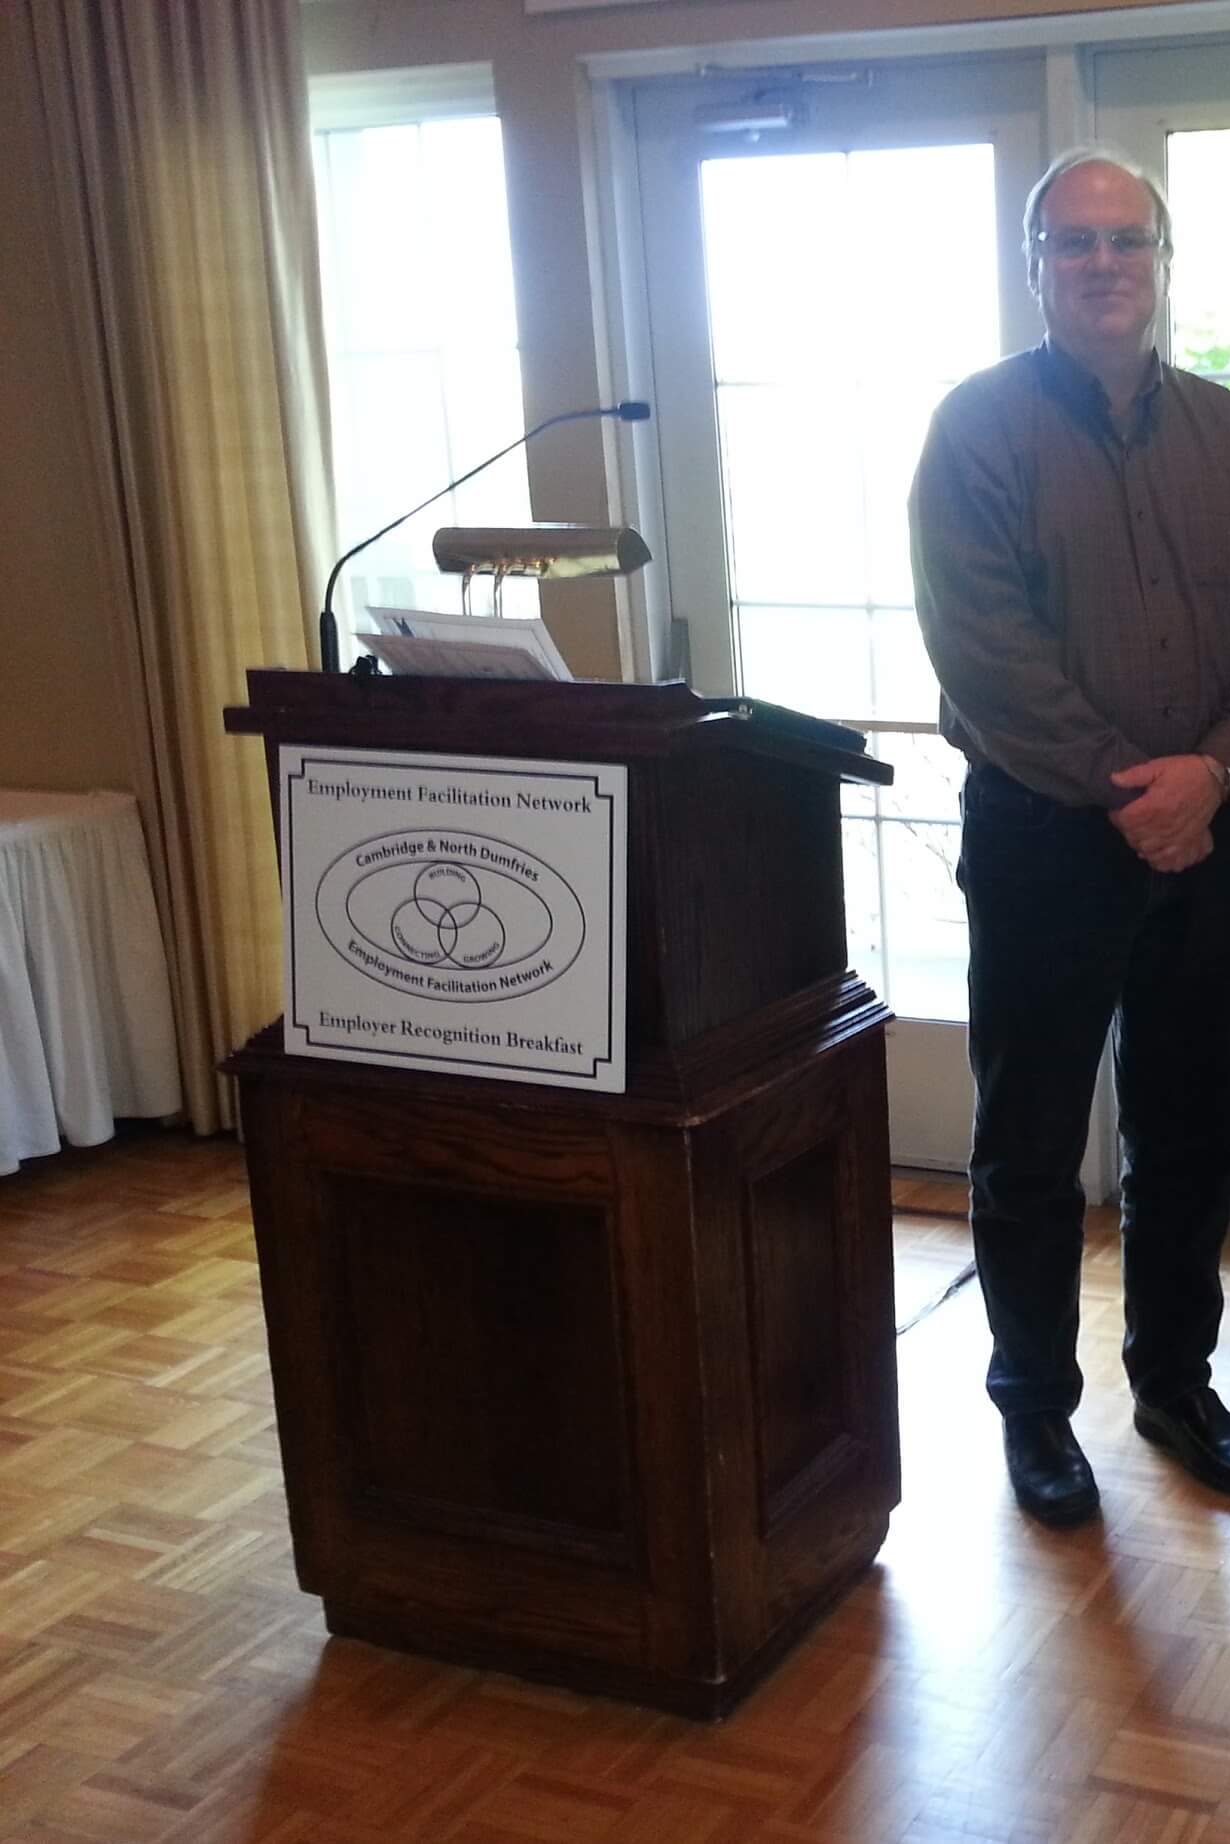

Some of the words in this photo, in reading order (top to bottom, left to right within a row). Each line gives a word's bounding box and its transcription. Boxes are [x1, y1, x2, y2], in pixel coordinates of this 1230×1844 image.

[307, 779, 413, 803] Employment
[418, 787, 511, 809] Facilitation
[516, 794, 592, 814] Network
[355, 840, 424, 868] Cambridge
[427, 839, 436, 852] &
[439, 839, 477, 857] North
[480, 846, 540, 882] Dumfries
[429, 867, 467, 883] BUILDING
[347, 940, 426, 988] Employment
[427, 978, 497, 994] Facilitation
[500, 960, 554, 989] Network
[463, 940, 500, 963] GROWING
[319, 1011, 397, 1036] Employer
[401, 1020, 501, 1047] Recognition
[506, 1032, 584, 1055] Breakfast
